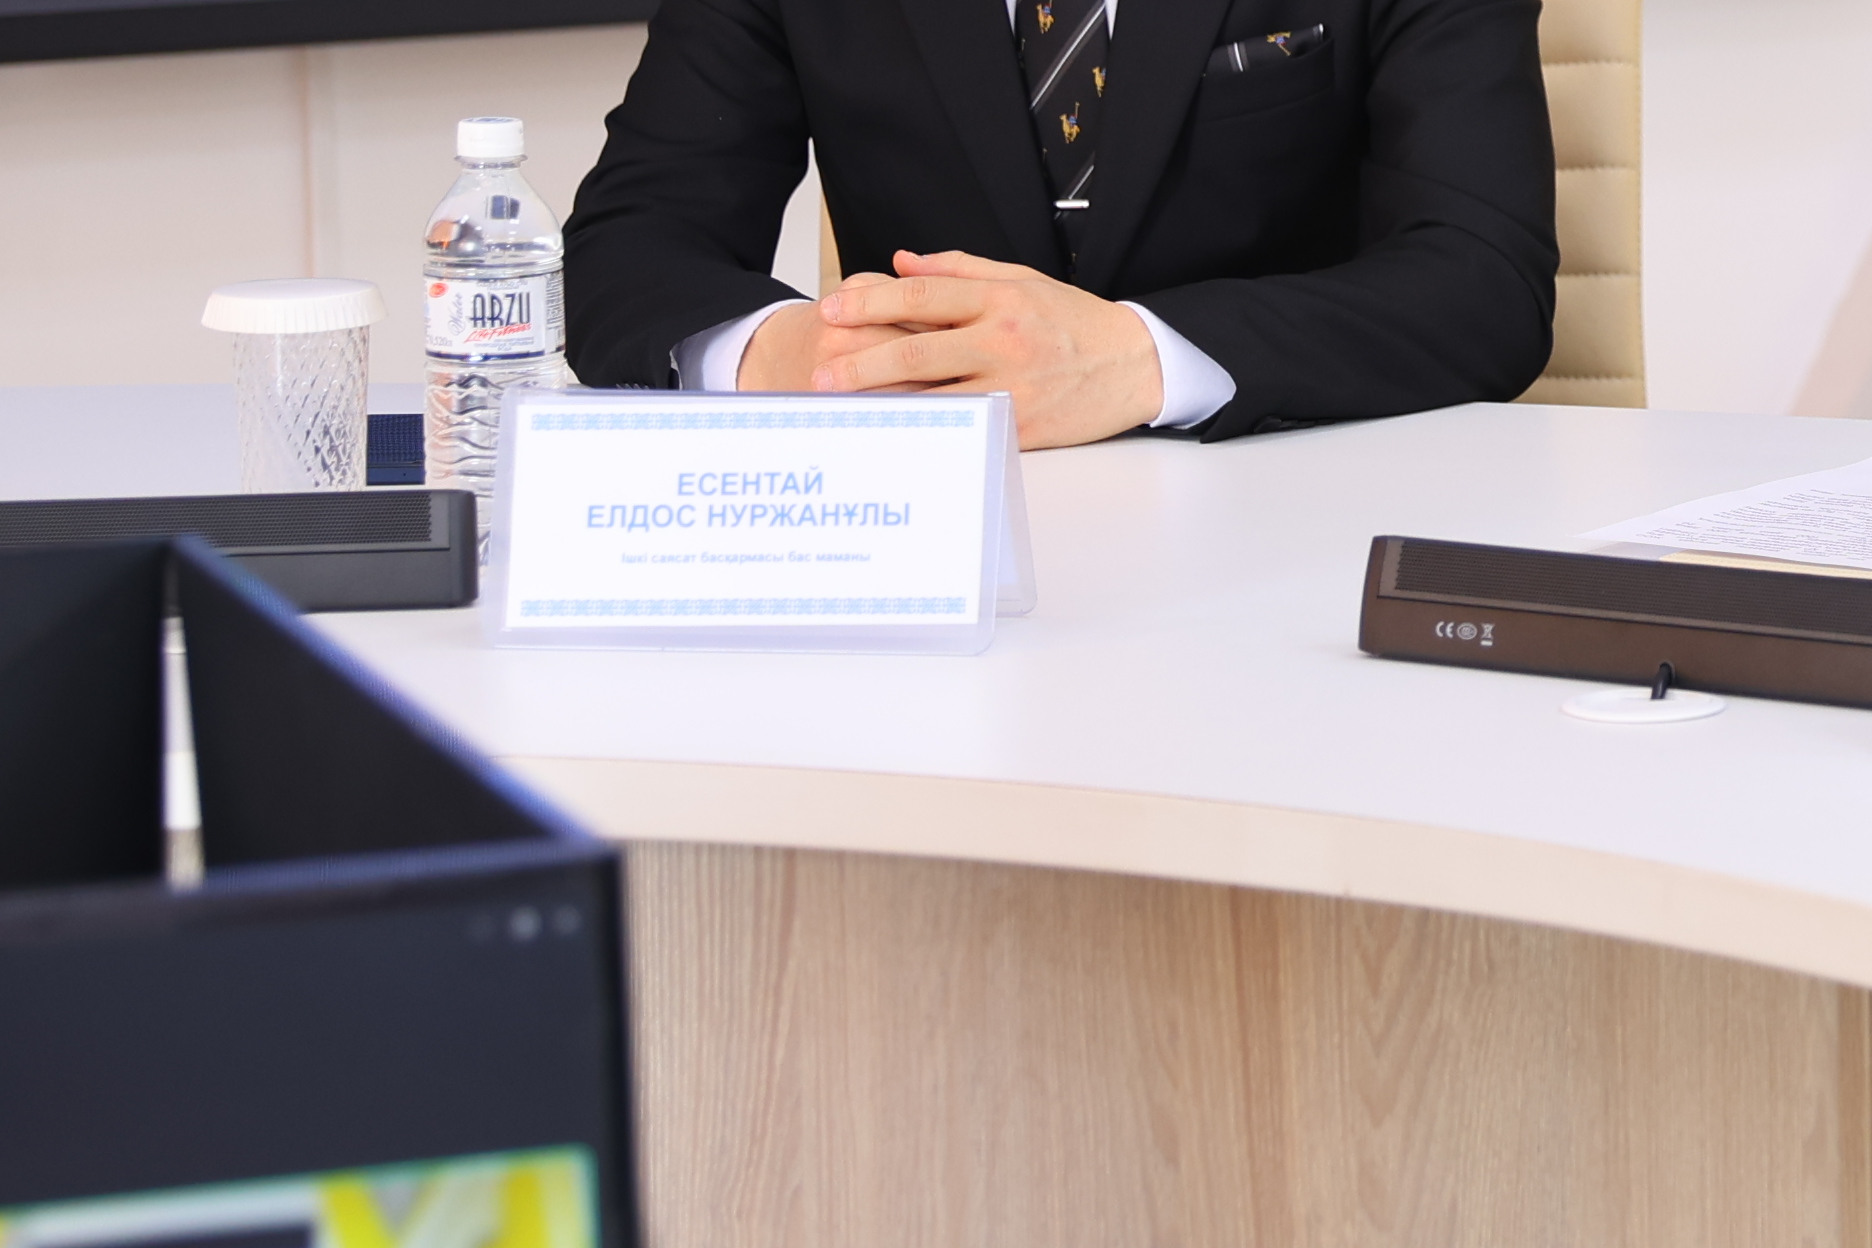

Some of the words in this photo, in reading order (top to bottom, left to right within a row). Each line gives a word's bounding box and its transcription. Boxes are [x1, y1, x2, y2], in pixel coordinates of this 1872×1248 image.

[469, 293, 531, 328] ARZU
[677, 465, 824, 497] ЕСЕНТАЙ
[587, 503, 697, 533] ЕЛДОС
[706, 502, 912, 529] НУРЖАНҰЛЫ
[651, 554, 697, 565] саясат
[700, 551, 784, 567] басқармасы
[787, 551, 812, 564] бас
[815, 553, 872, 564] маманы
